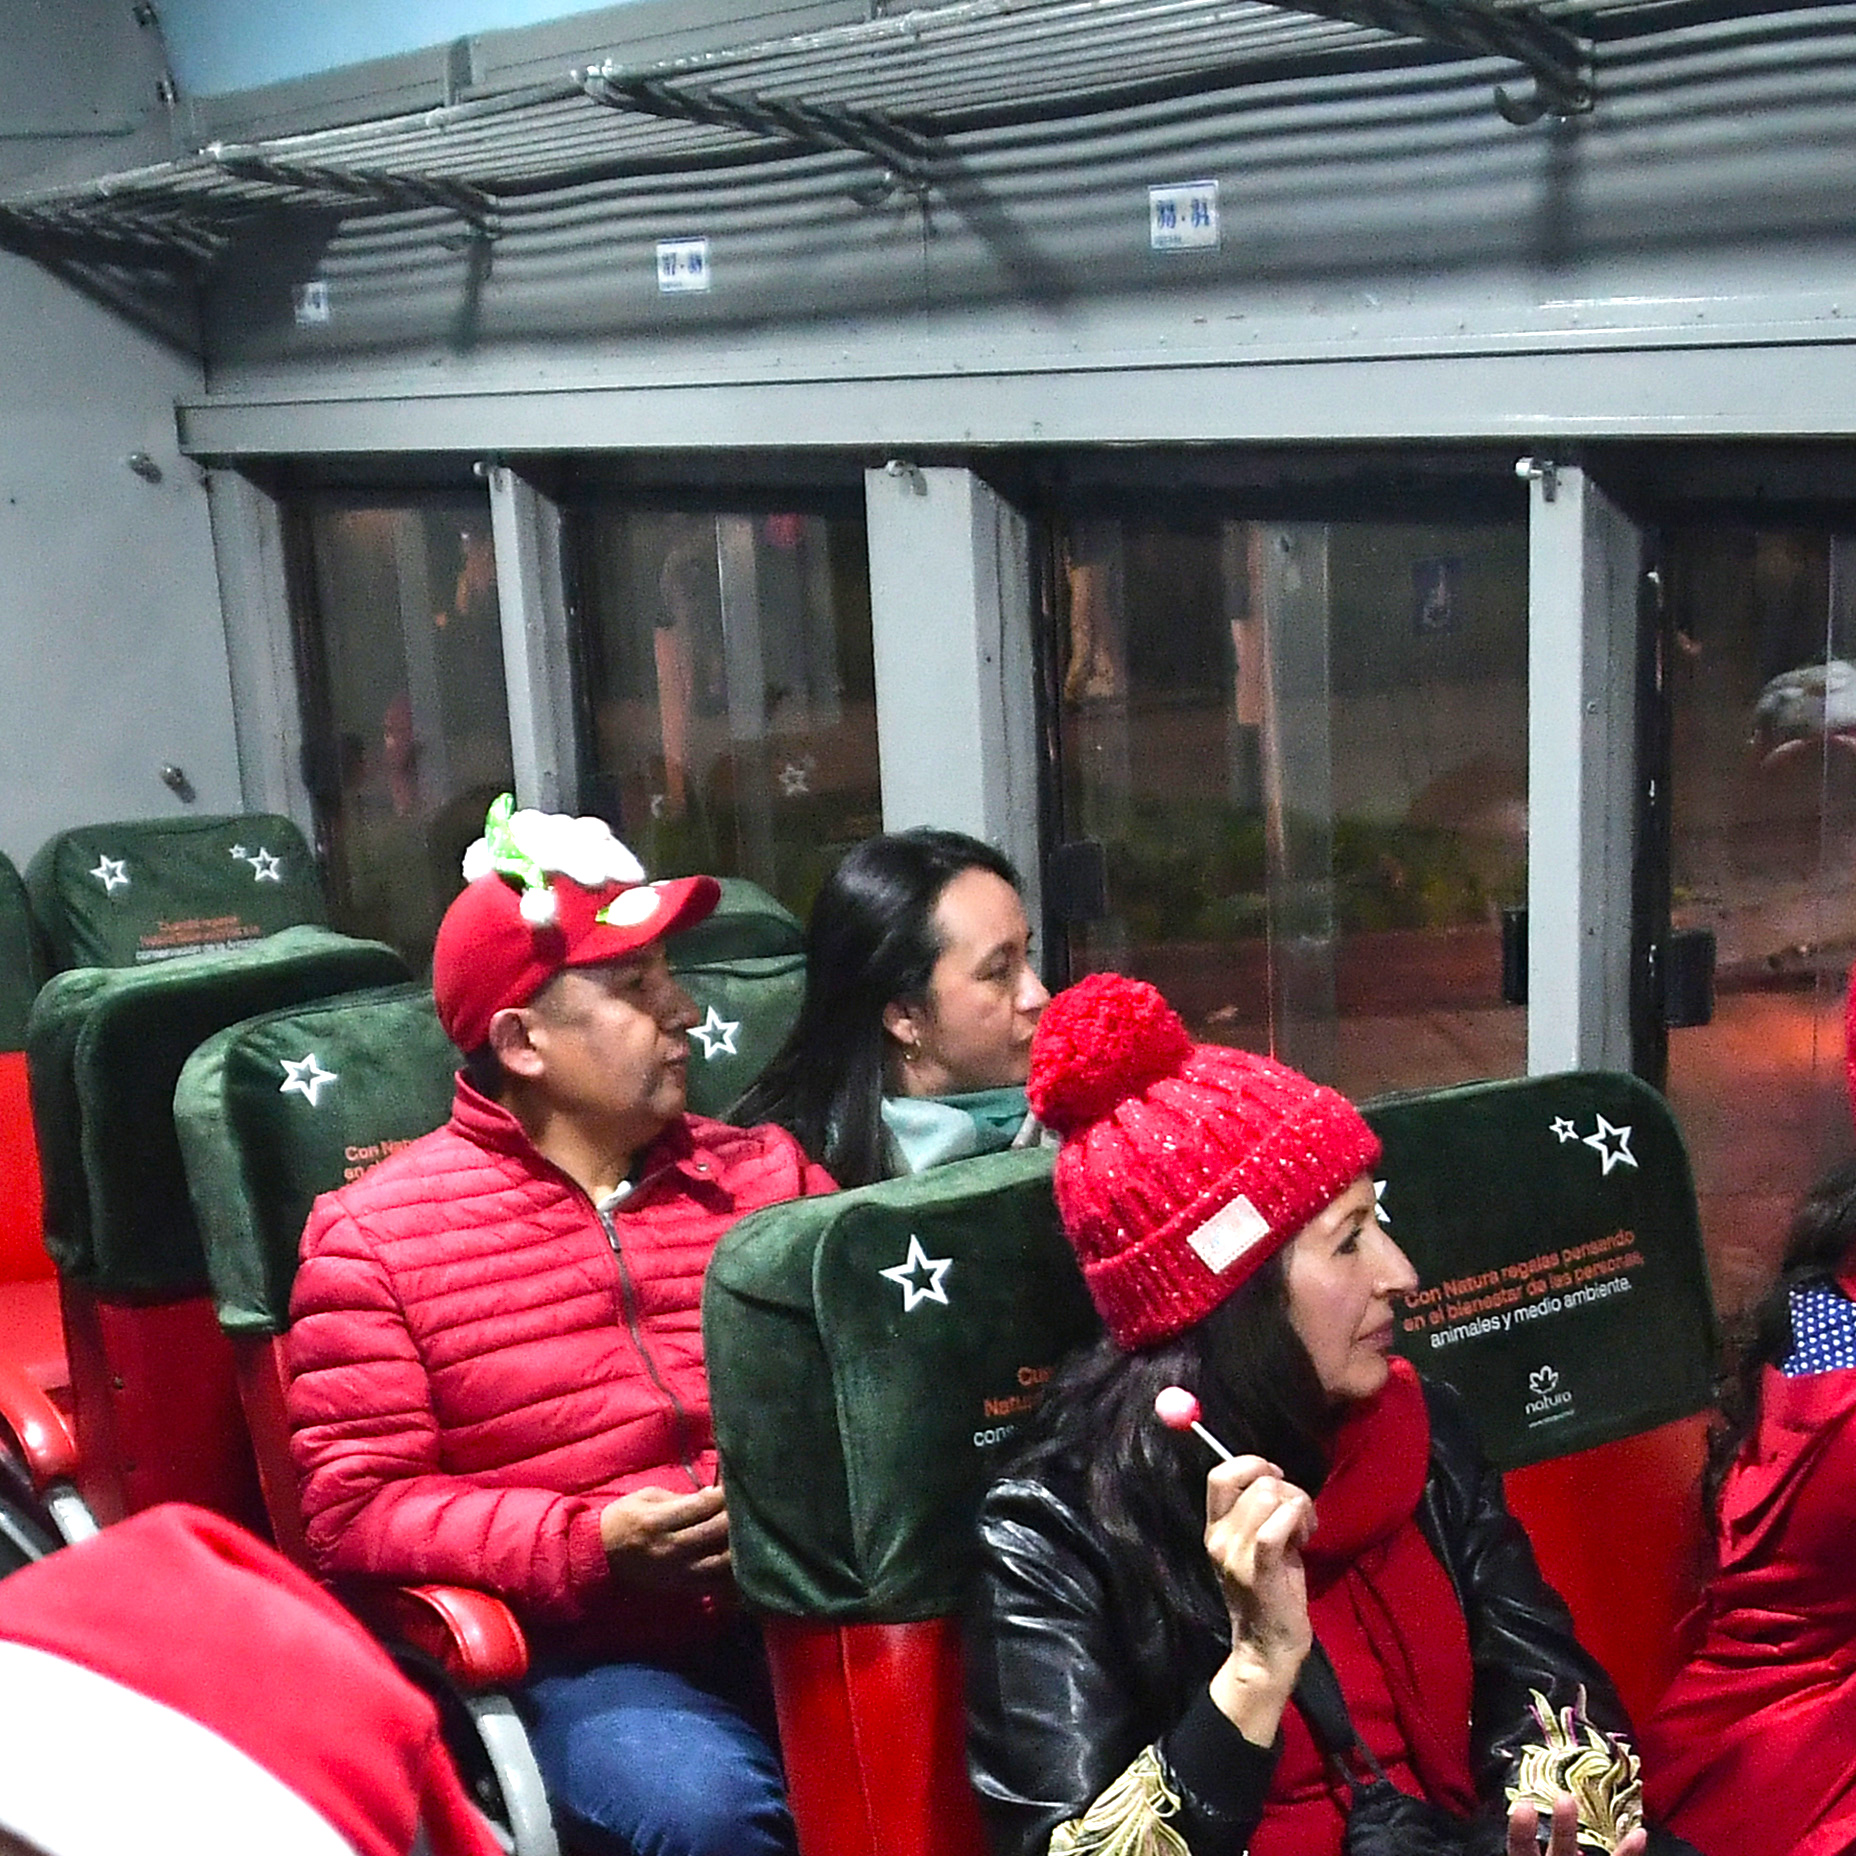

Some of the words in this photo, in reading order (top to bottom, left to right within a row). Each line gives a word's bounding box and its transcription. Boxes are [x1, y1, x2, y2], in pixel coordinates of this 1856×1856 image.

[345, 1145, 379, 1162] Con
[1404, 1283, 1443, 1309] Con
[1442, 1267, 1500, 1299] Natura
[1501, 1251, 1560, 1281] regalas
[1562, 1228, 1635, 1268] pensando
[1403, 1313, 1426, 1333] en
[1428, 1305, 1445, 1326] el
[1447, 1283, 1523, 1321] bienestar
[1526, 1277, 1548, 1297] de
[1549, 1269, 1573, 1290] las
[1430, 1313, 1501, 1349] animales
[1501, 1311, 1513, 1332] y
[1514, 1294, 1562, 1325] medio
[1525, 1390, 1573, 1415] natura
